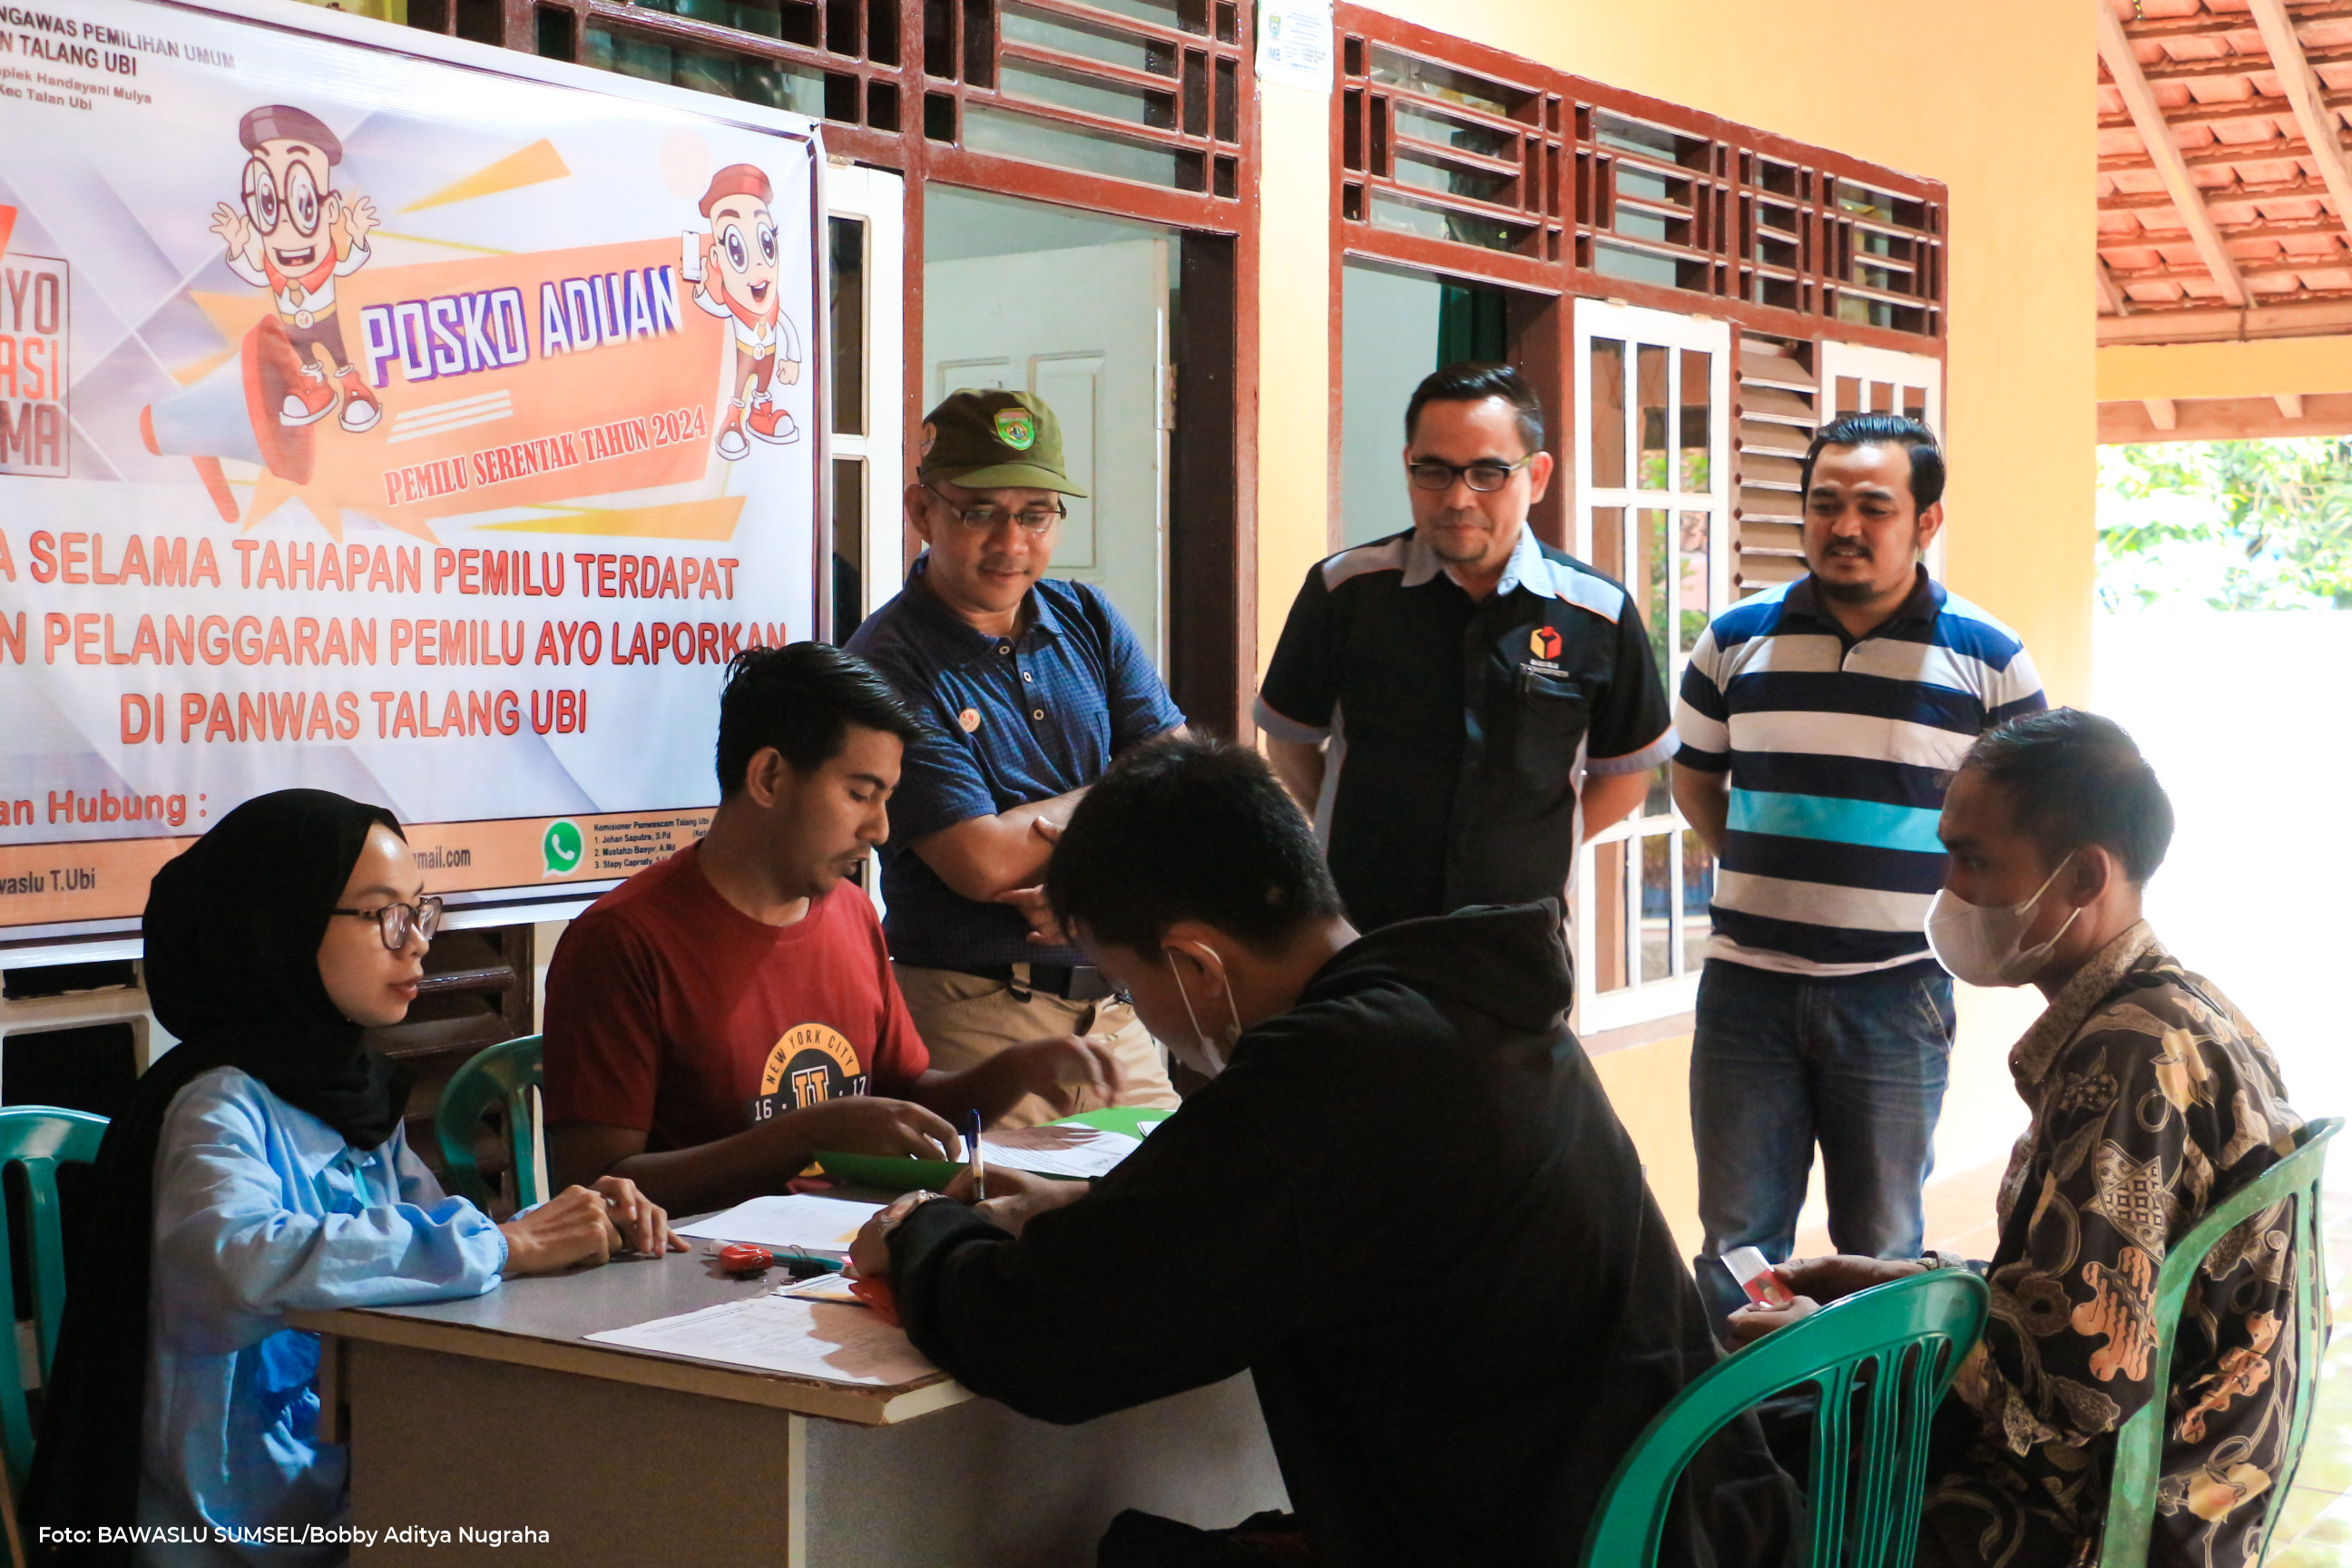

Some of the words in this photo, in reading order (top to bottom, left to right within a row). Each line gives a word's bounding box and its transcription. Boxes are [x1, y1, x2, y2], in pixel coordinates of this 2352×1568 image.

[19, 34, 98, 69] TALANG
[104, 51, 136, 76] UBI
[83, 23, 180, 59] PEMILIHAN
[183, 44, 236, 69] UMUM
[27, 88, 64, 105] Talan
[69, 95, 93, 111] Ubi
[37, 72, 110, 96] Handayani
[113, 86, 152, 104] Mulya
[359, 286, 531, 388] POSKO
[539, 264, 683, 360] ADUAN
[383, 457, 468, 506] PEMILU
[472, 433, 579, 486] SERENTAK
[580, 417, 648, 460] TAHUN
[652, 405, 707, 447] 2024
[30, 530, 220, 588] SELAMA
[232, 540, 421, 593] TAHAPAN
[435, 547, 564, 597] PEMILU
[574, 554, 740, 600] TERDAPAT
[44, 612, 377, 666] PELANGGARAN
[390, 619, 524, 666] PEMILU
[534, 621, 603, 666] AYO
[121, 692, 164, 744] DI
[181, 691, 360, 743] PANWAS
[370, 690, 520, 738] TALANG
[531, 689, 587, 735] UBI
[48, 789, 186, 827] Hubung
[593, 822, 632, 831] Komisioner
[633, 819, 674, 829] Panwascam
[676, 818, 697, 827] Talang
[603, 835, 623, 844] Johan
[656, 832, 671, 840] S.Pd
[50, 867, 95, 892] T.Ubi
[766, 1048, 787, 1085] NEW
[789, 1029, 820, 1049] YORK
[828, 1035, 854, 1066] CITY
[755, 1098, 772, 1121] 16
[852, 1076, 867, 1096] 17
